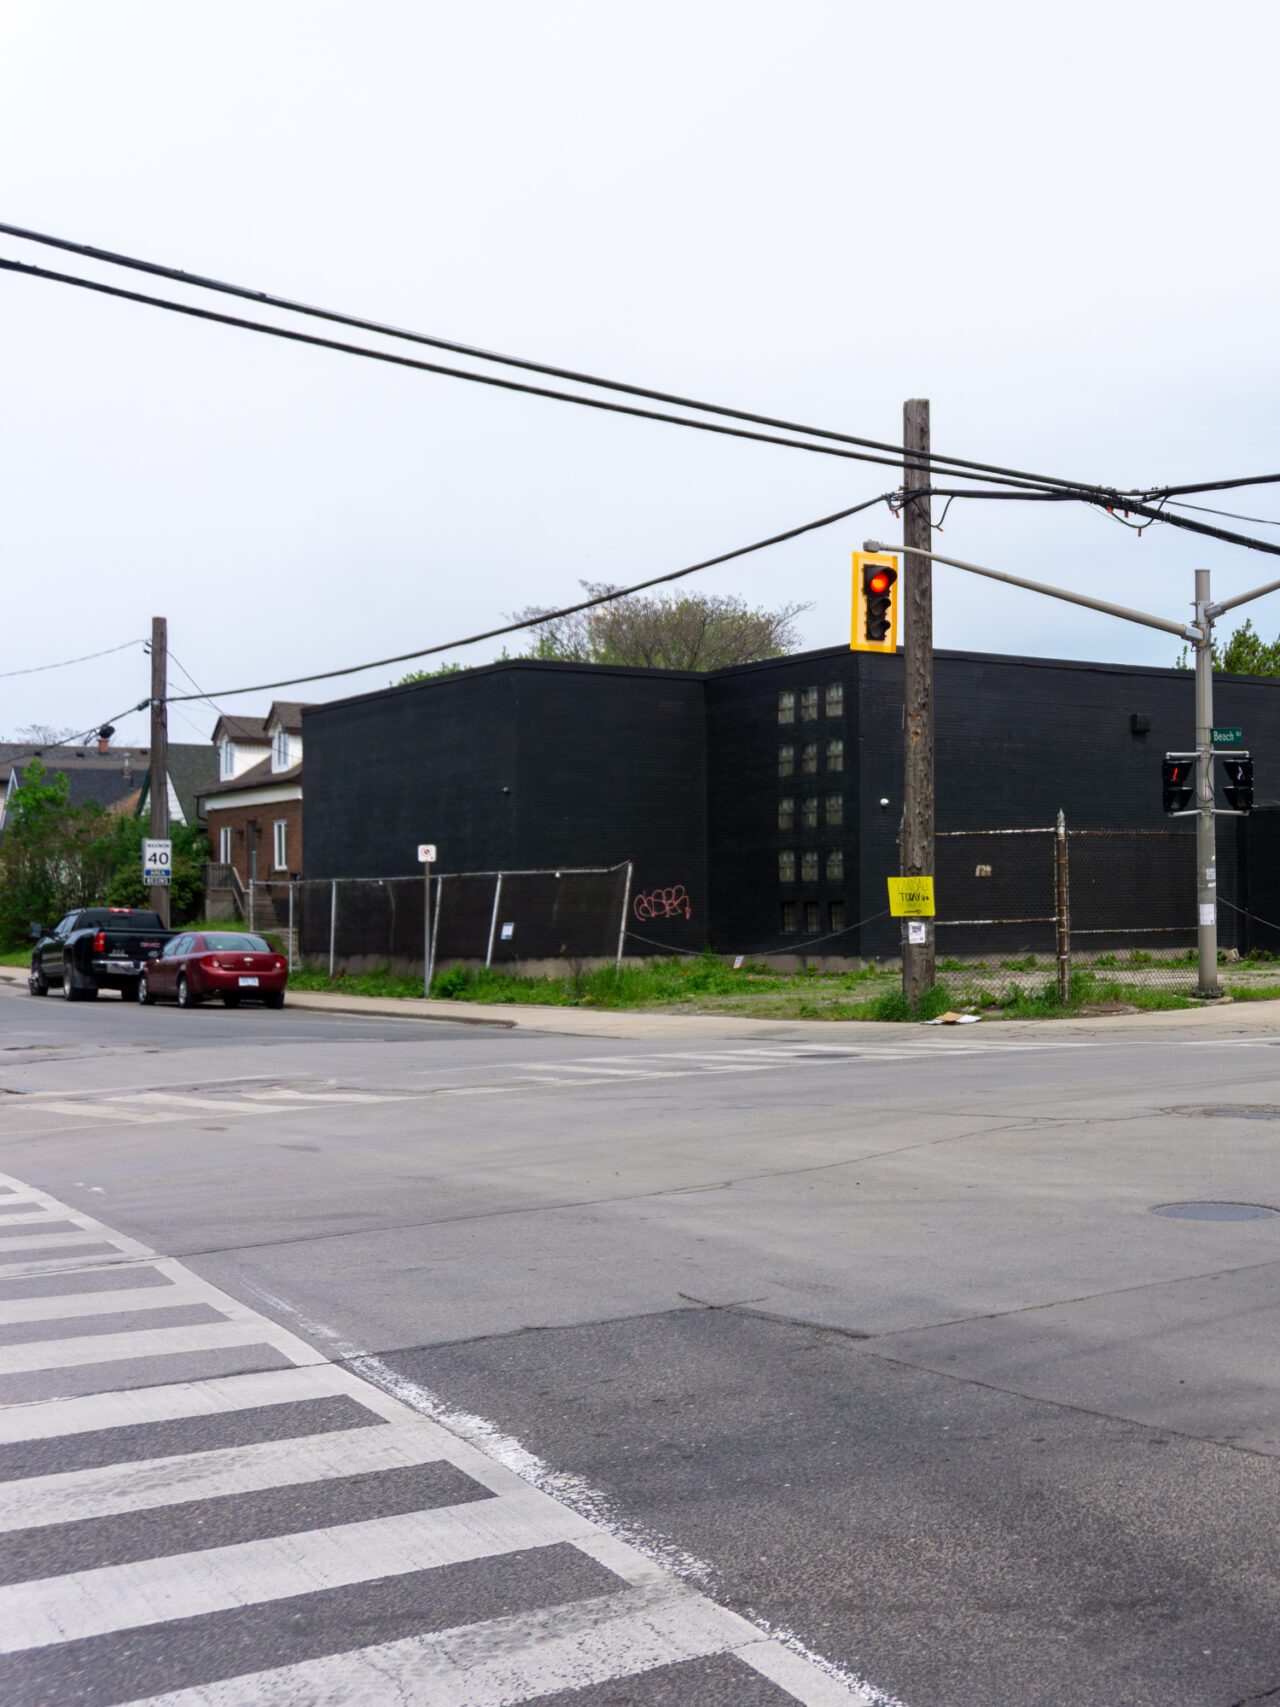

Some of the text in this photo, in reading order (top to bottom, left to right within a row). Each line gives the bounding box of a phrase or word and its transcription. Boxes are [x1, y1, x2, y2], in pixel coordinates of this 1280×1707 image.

[1213, 730, 1235, 741] Beach
[148, 852, 169, 865] 40
[898, 892, 921, 902] TODAY
